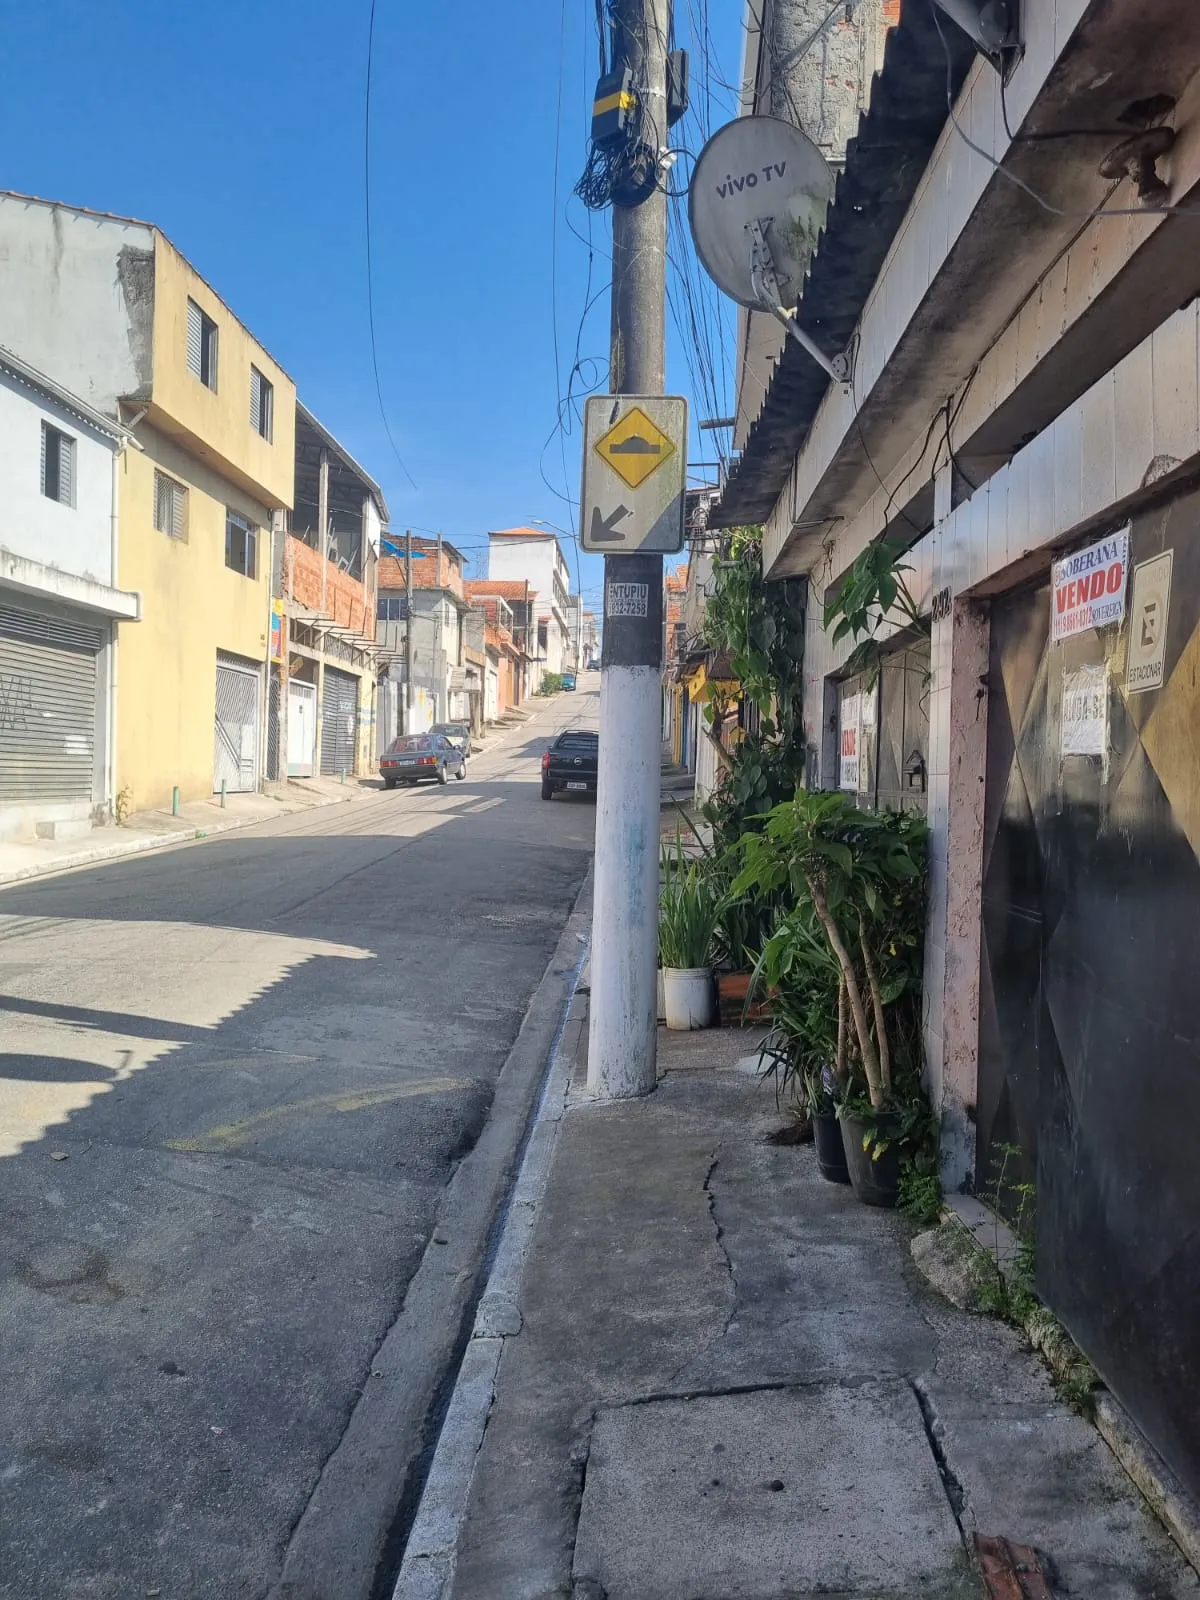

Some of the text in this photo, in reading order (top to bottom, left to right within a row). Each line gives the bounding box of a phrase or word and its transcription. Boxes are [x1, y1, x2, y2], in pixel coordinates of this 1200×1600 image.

[716, 161, 787, 199] vivo TV
[1060, 541, 1118, 580] SOBERANA
[610, 585, 646, 598] ENTUPIU
[1056, 562, 1122, 614] VENDO
[1129, 661, 1162, 683] ESTACIONAR
